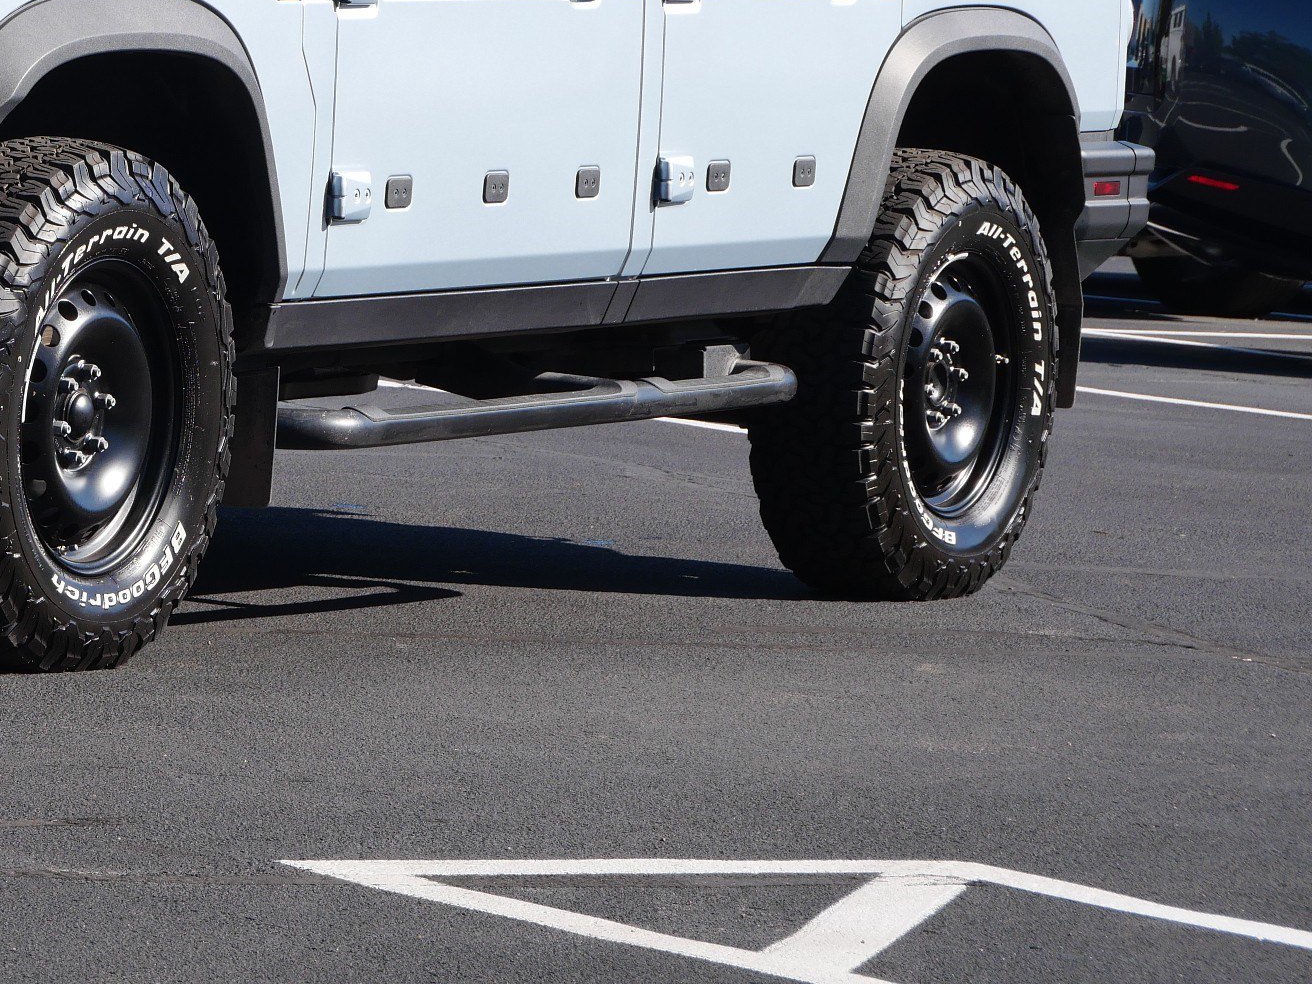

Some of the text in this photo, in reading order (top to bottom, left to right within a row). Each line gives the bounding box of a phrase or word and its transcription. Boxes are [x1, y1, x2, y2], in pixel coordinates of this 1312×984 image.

[976, 221, 1045, 416] All-Terrain T/A
[51, 520, 187, 610] BFGoodrich
